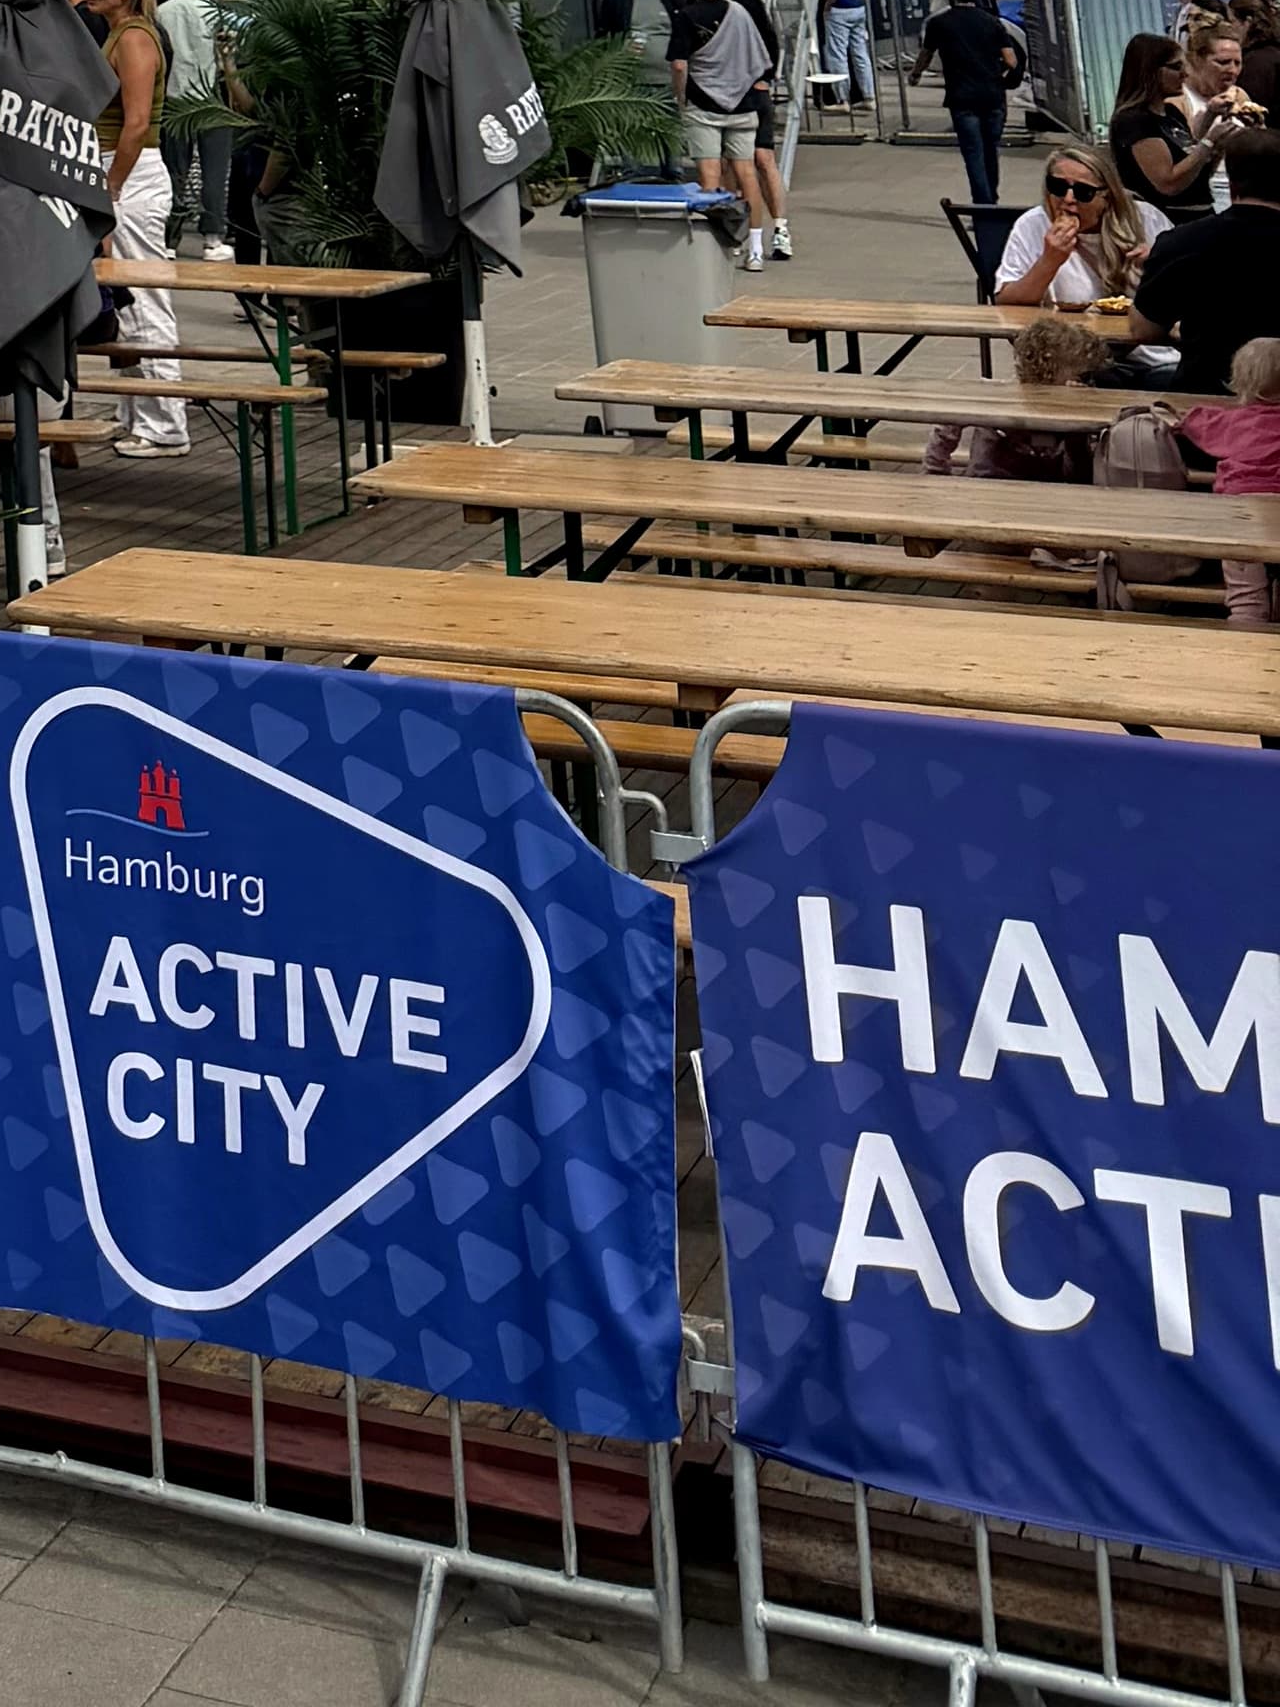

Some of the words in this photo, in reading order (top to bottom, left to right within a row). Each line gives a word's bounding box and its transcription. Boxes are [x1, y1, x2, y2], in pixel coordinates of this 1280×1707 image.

[65, 838, 265, 917] Hamburg
[89, 936, 447, 1073] ACTIVE
[797, 895, 1280, 1125] HAM
[107, 1052, 325, 1166] CITY
